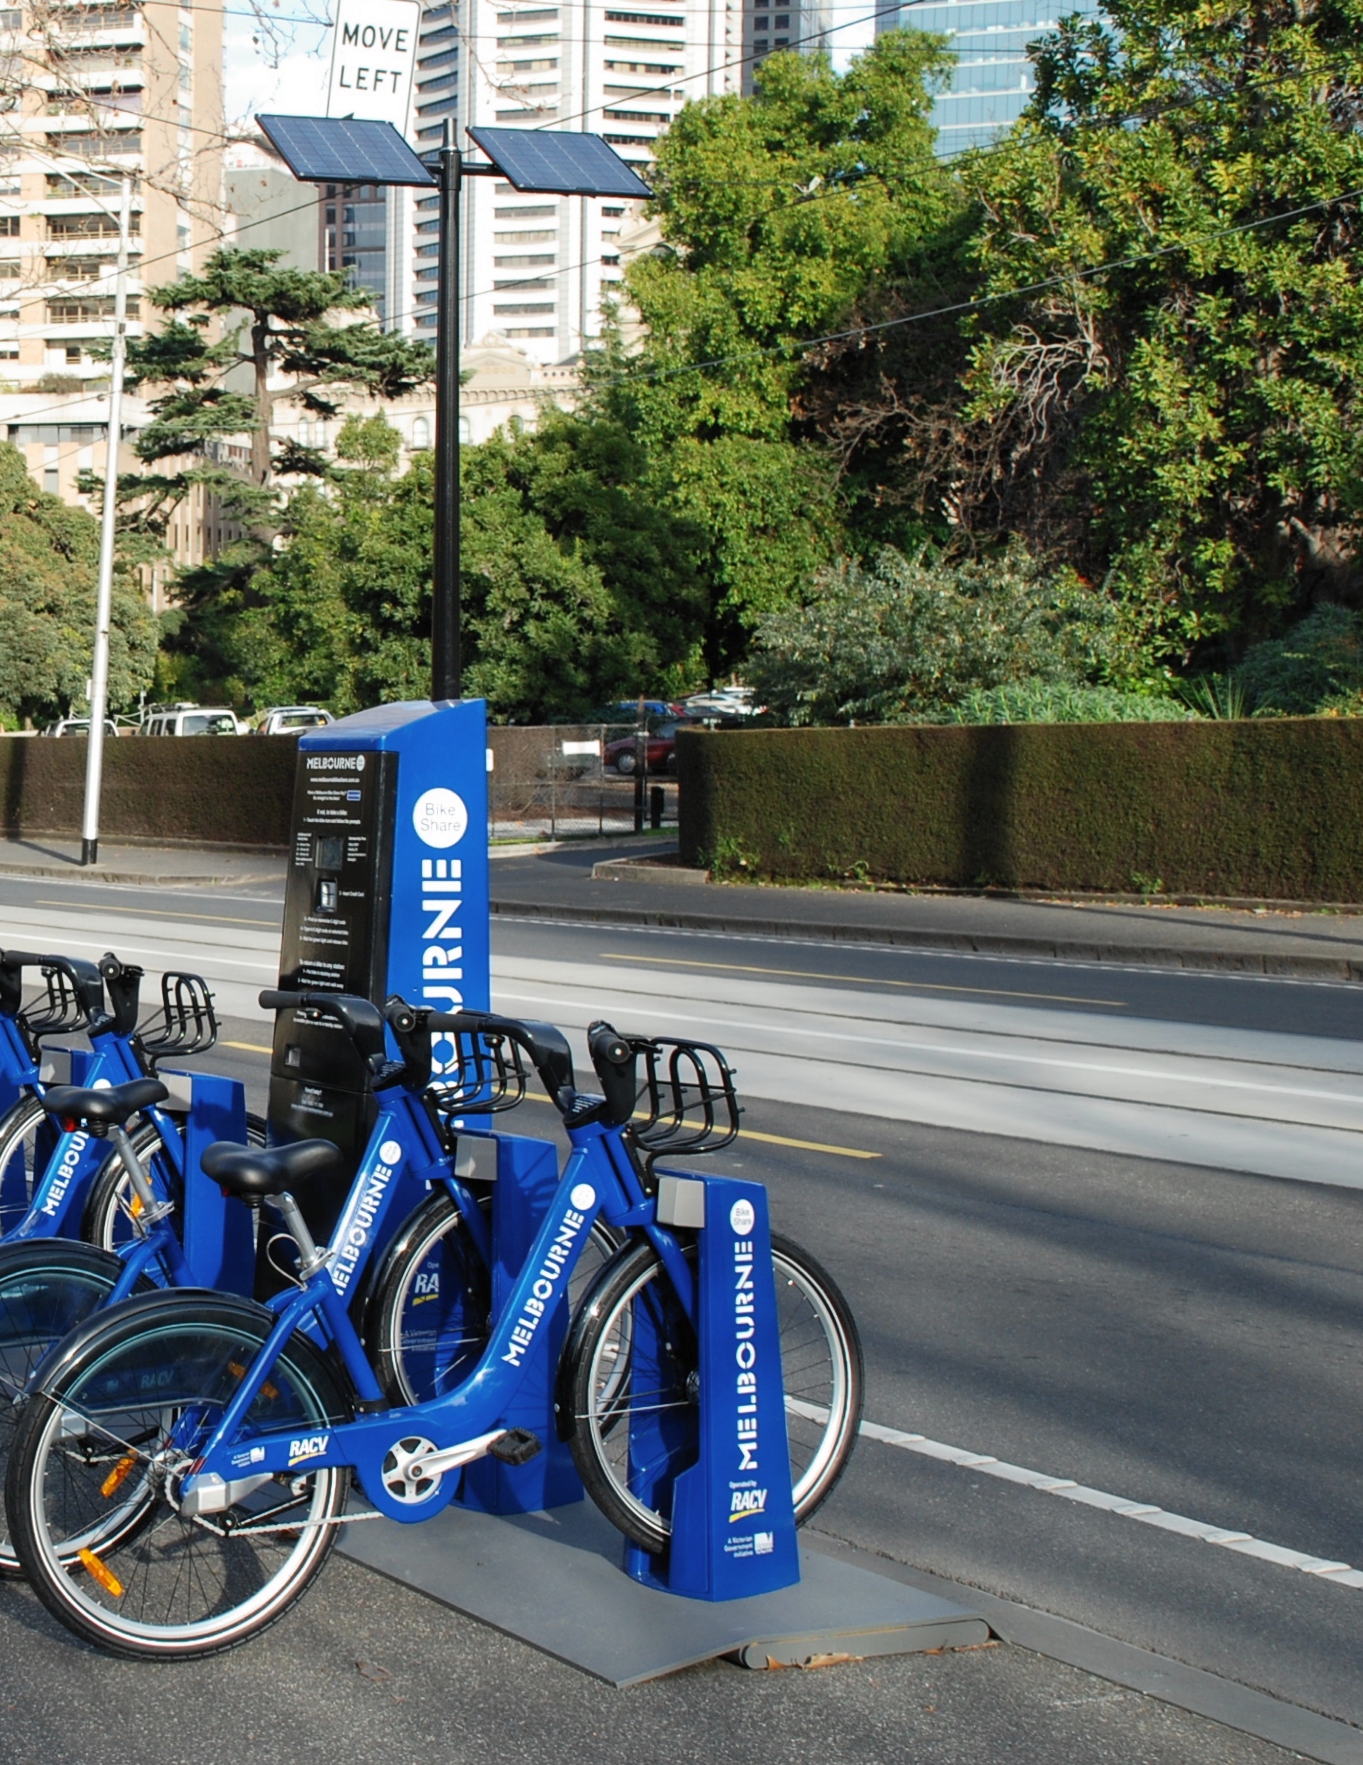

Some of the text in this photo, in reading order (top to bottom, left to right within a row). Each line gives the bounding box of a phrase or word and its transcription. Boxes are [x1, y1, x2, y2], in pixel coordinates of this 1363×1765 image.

[342, 21, 409, 52] MOVE
[339, 65, 402, 94] LEFT
[306, 756, 356, 770] MELBOURNE
[425, 802, 456, 816] Bike
[420, 817, 461, 832] Share
[735, 1207, 750, 1217] Bike
[333, 1163, 393, 1296] ELBOURNE
[501, 1209, 585, 1367] MELBOURNE
[734, 1241, 759, 1470] MELBOURNE
[140, 1369, 175, 1389] RACV
[289, 1434, 330, 1458] RACV
[730, 1488, 768, 1512] RACV
